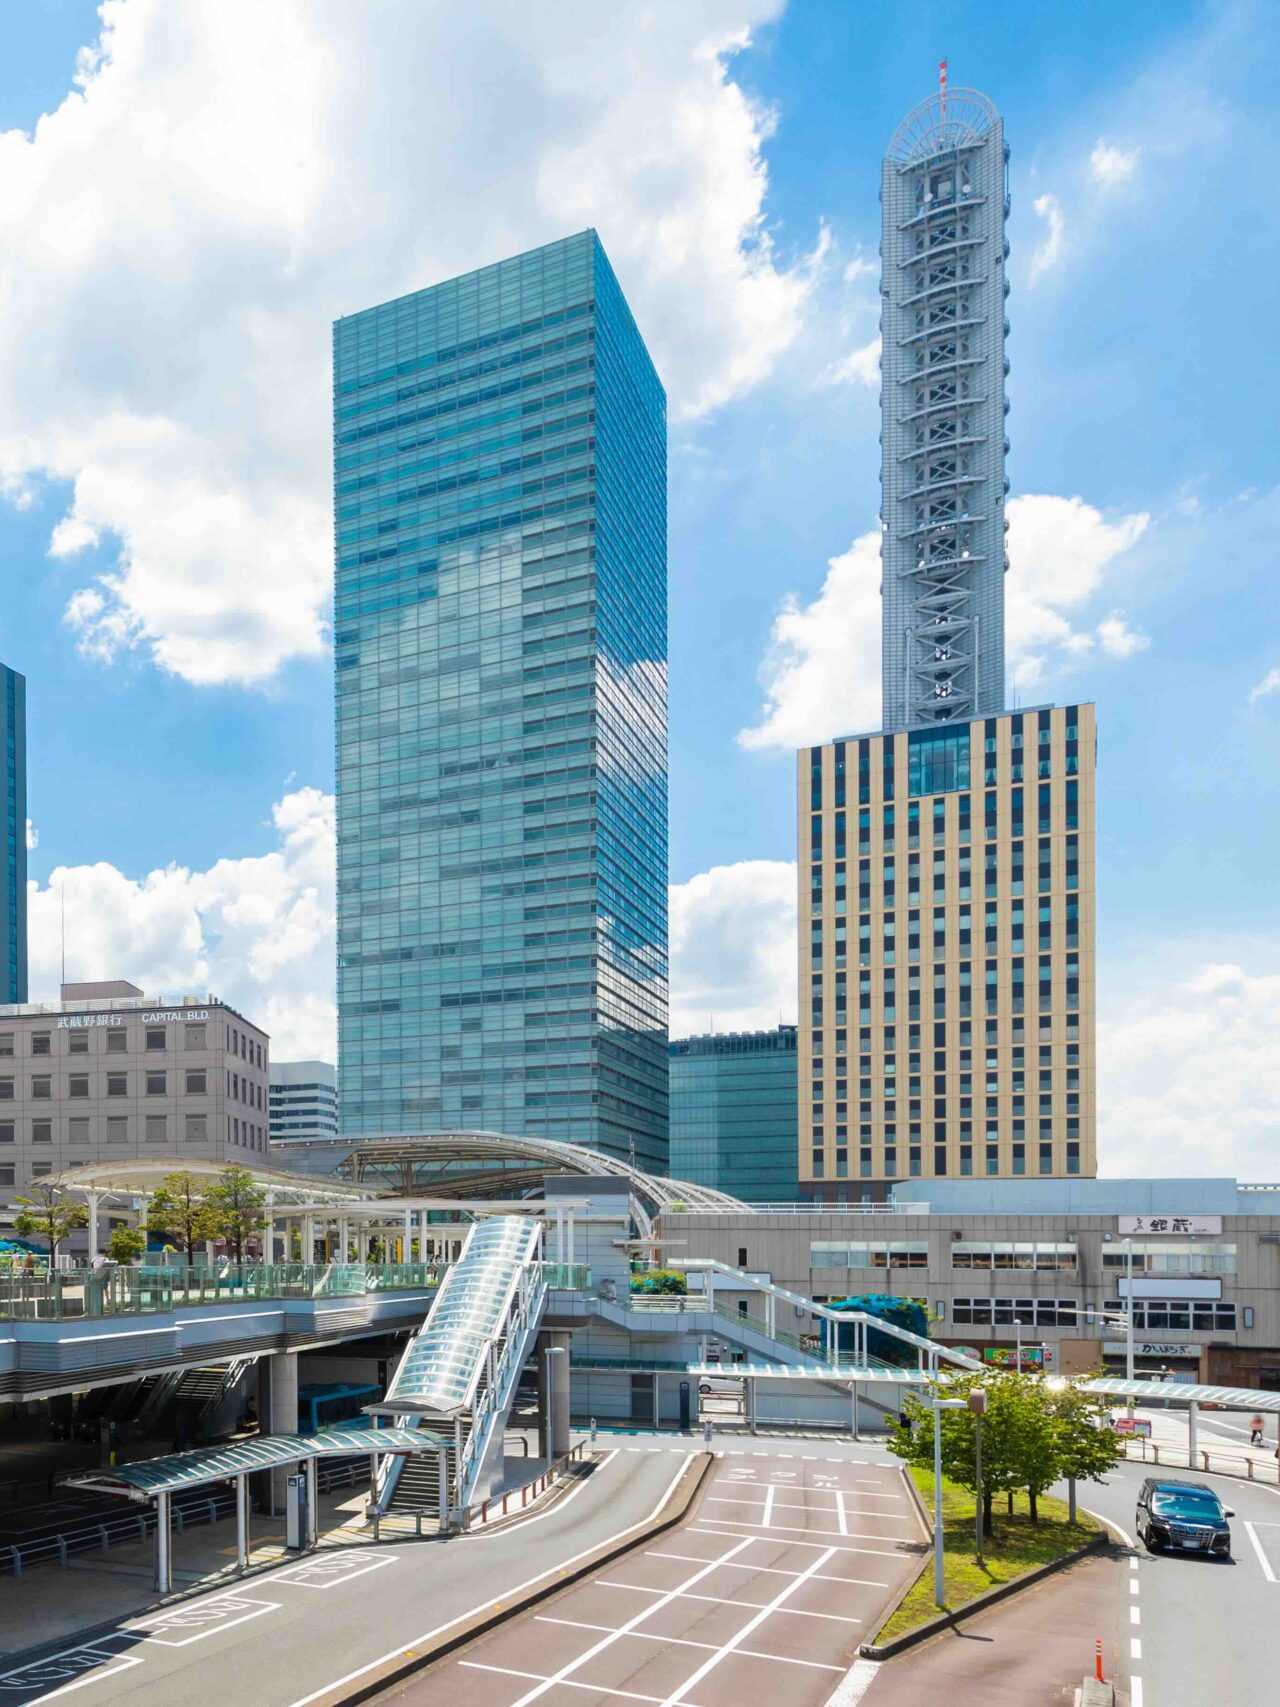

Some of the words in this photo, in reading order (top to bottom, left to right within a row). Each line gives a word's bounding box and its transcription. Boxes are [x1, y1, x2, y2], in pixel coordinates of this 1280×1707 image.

[56, 1013, 122, 1029] 武蔵野銀行
[141, 1012, 186, 1023] CAPITAL
